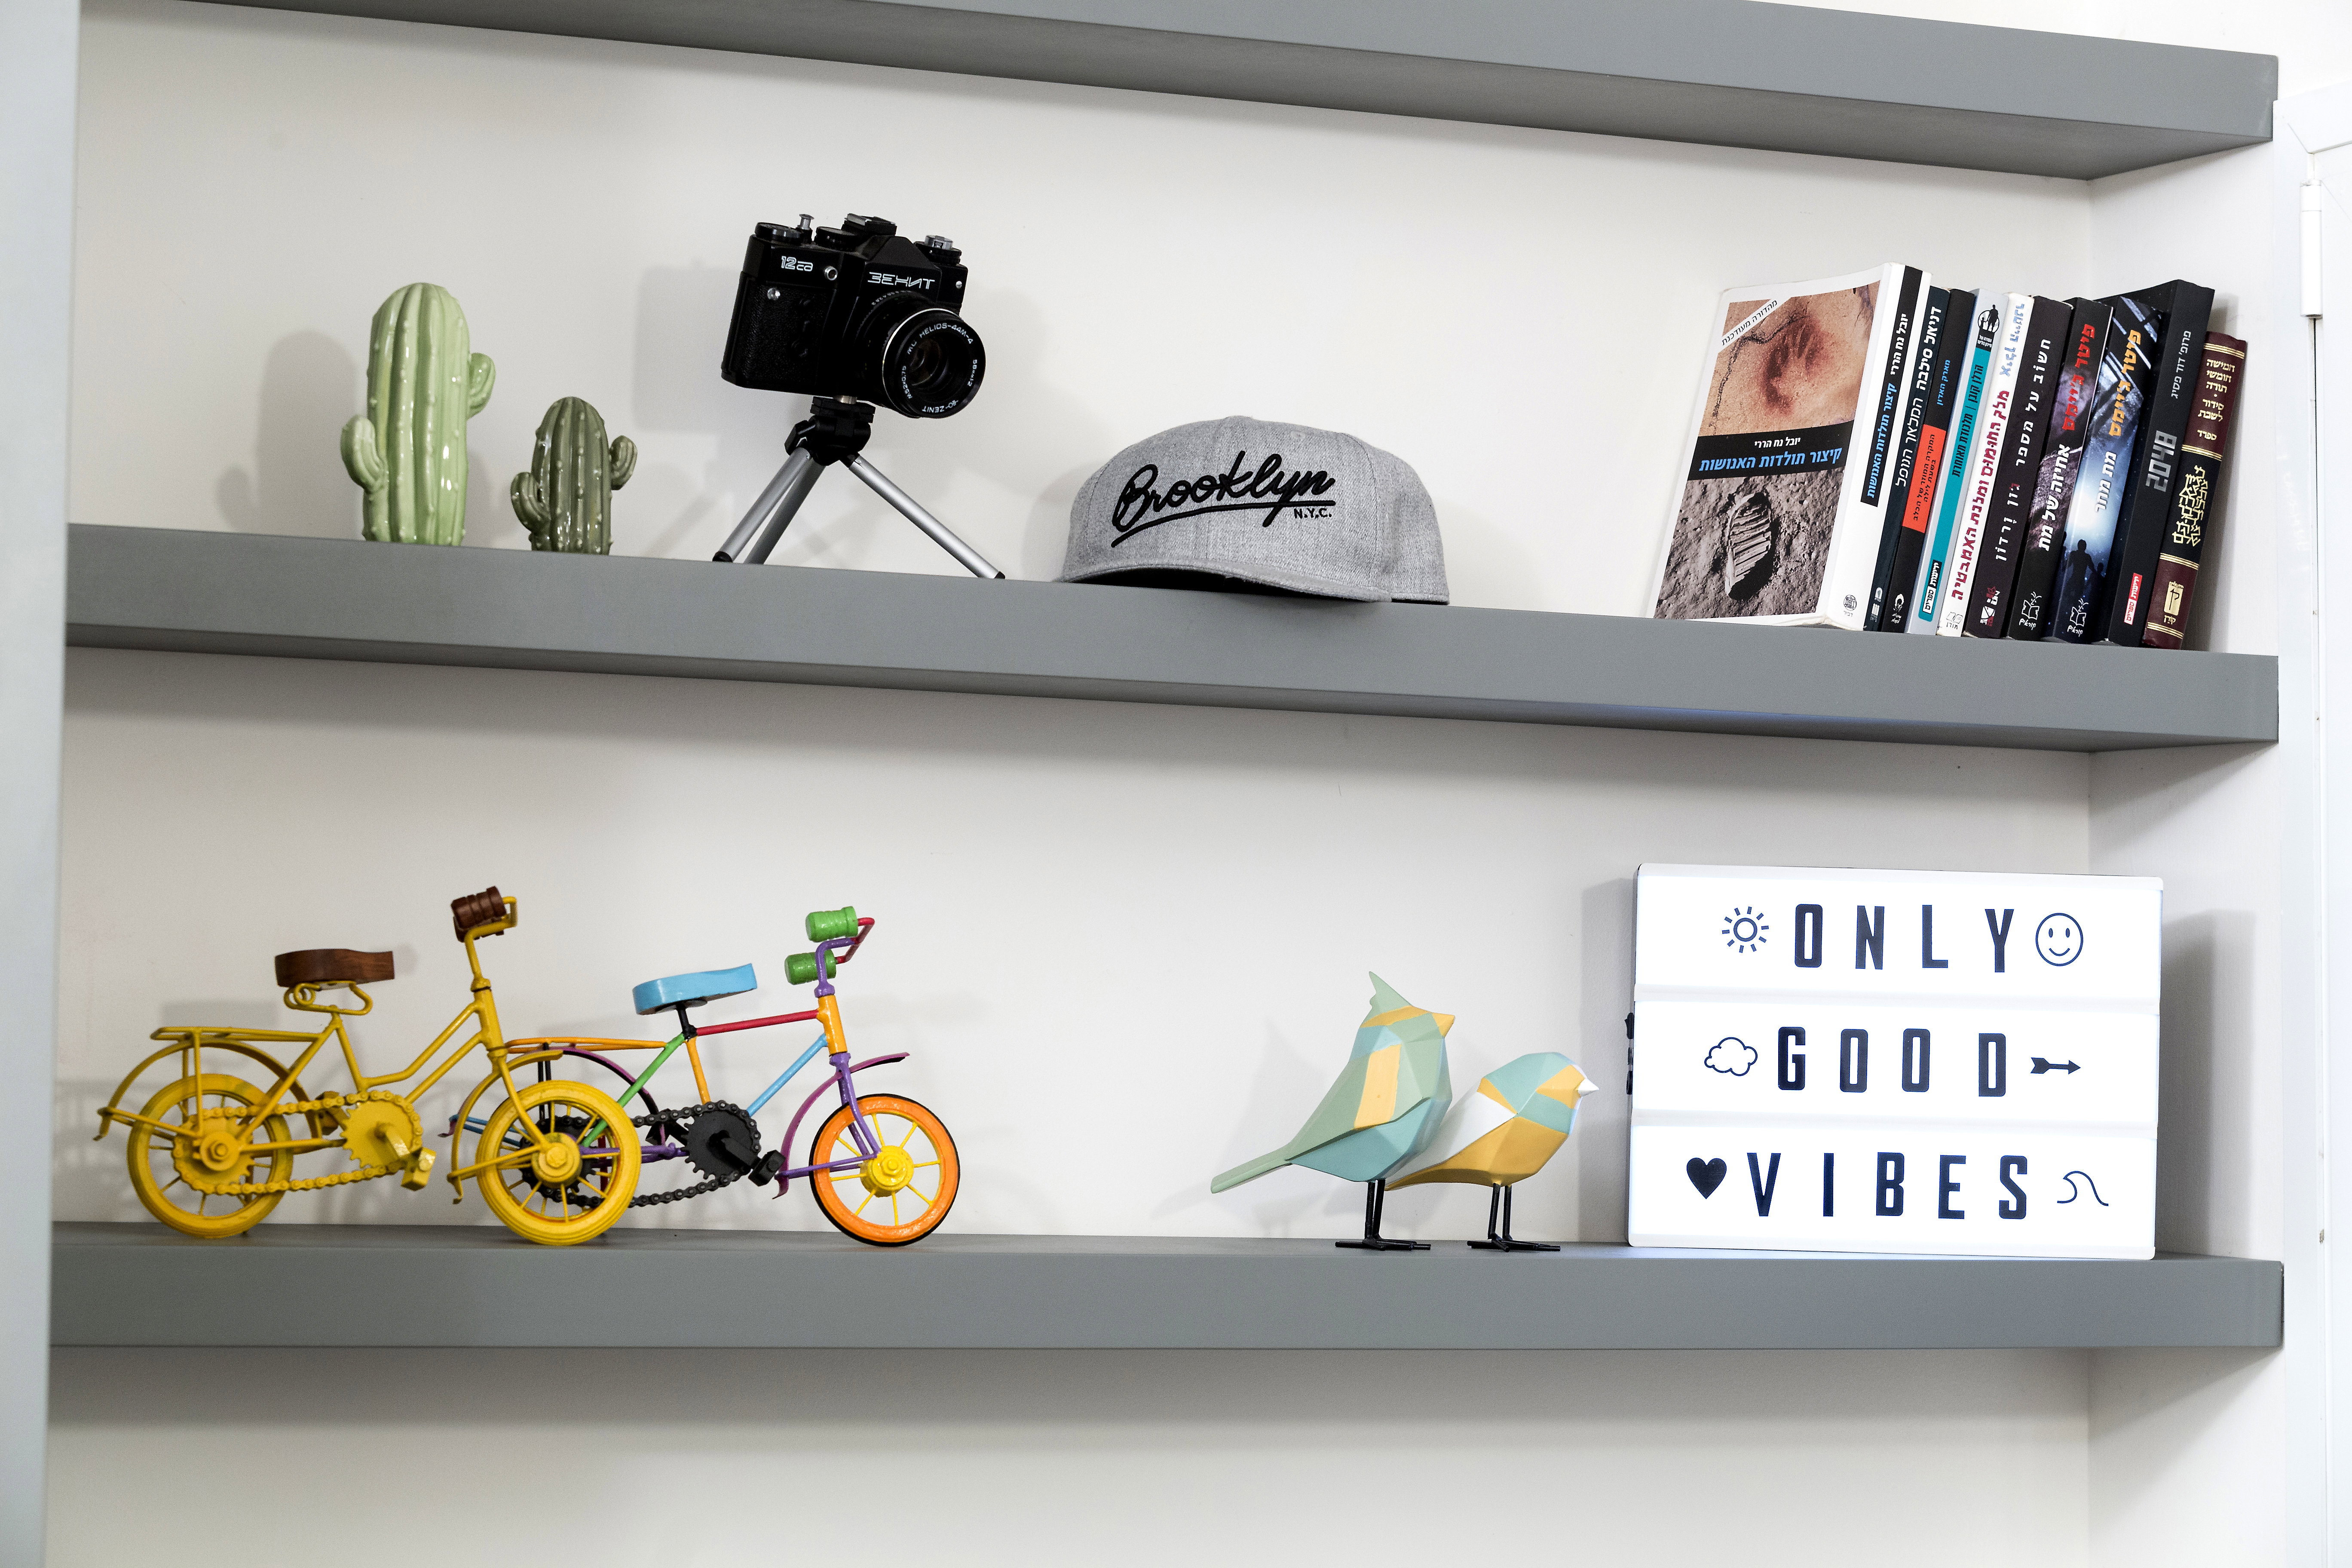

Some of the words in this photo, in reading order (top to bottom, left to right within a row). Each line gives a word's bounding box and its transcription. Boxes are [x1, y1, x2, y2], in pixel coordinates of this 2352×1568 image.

[867, 271, 935, 290] ЗЕНИТ
[1752, 300, 1778, 322] מהדורה
[1722, 320, 1751, 346] מעודכנת
[1896, 313, 1908, 334] יובל
[1923, 306, 1942, 345] דניאל
[1895, 337, 1905, 350] נח
[2074, 323, 2095, 368] פיטר
[2121, 329, 2142, 375] פיטר
[1890, 352, 1902, 375] הררי
[1916, 348, 1933, 391] סילבה
[1942, 359, 1951, 382] מארק
[1999, 346, 2017, 377] אילן
[2175, 356, 2186, 374] דוד
[2206, 358, 2236, 373] חמישה
[1971, 364, 1984, 385] הרלן
[2206, 369, 2232, 383] חומשי
[1883, 383, 1897, 411] קיצור
[1937, 383, 1946, 406] האדון
[2171, 375, 2182, 399] פסיג
[2206, 381, 2227, 393] תורה
[1992, 390, 2009, 421] מלך
[2025, 390, 2040, 412] על
[2202, 398, 2224, 411] סידור
[1905, 398, 1923, 444] המלאך
[2197, 409, 2223, 422] לשבת
[1876, 414, 1890, 452] תולדות
[1959, 413, 1973, 444] מלכודת
[2197, 429, 2217, 441] ספרד
[1754, 440, 1772, 448] הררי
[1773, 439, 1783, 447] נח
[1785, 436, 1801, 446] יובל
[1926, 434, 1935, 461] המקרה
[2015, 420, 2034, 466] מספר
[1699, 456, 1756, 472] האנושות
[1758, 451, 1806, 468] תולדות
[1810, 447, 1843, 464] קיצור
[1895, 448, 1913, 487] הנופל
[1951, 444, 1966, 478] מאוחרת
[2102, 451, 2117, 478] מת
[2145, 430, 2177, 492] 2048
[1867, 453, 1882, 498] האנושות
[1920, 463, 1929, 485] המוזר
[1927, 459, 1936, 484] בשעת
[2050, 443, 2070, 493] אחיזה
[1112, 450, 1336, 532] Brooklyn
[1917, 487, 1924, 499] של
[1970, 480, 1990, 525] ומלכת
[2095, 479, 2111, 513] מחר
[1294, 508, 1332, 520] N.Y.C.
[1913, 501, 1921, 521] הכלב
[2042, 494, 2059, 521] של
[2038, 524, 2054, 552] מת
[1951, 527, 1977, 601] האמבטיה
[1924, 589, 1934, 610] ספרים
[2126, 601, 2135, 621] ספרים
[1946, 622, 1958, 630] מודן
[1794, 903, 2015, 973] ONLY
[1777, 1026, 2006, 1097] GOOD
[1746, 1151, 2028, 1219] VIBES
